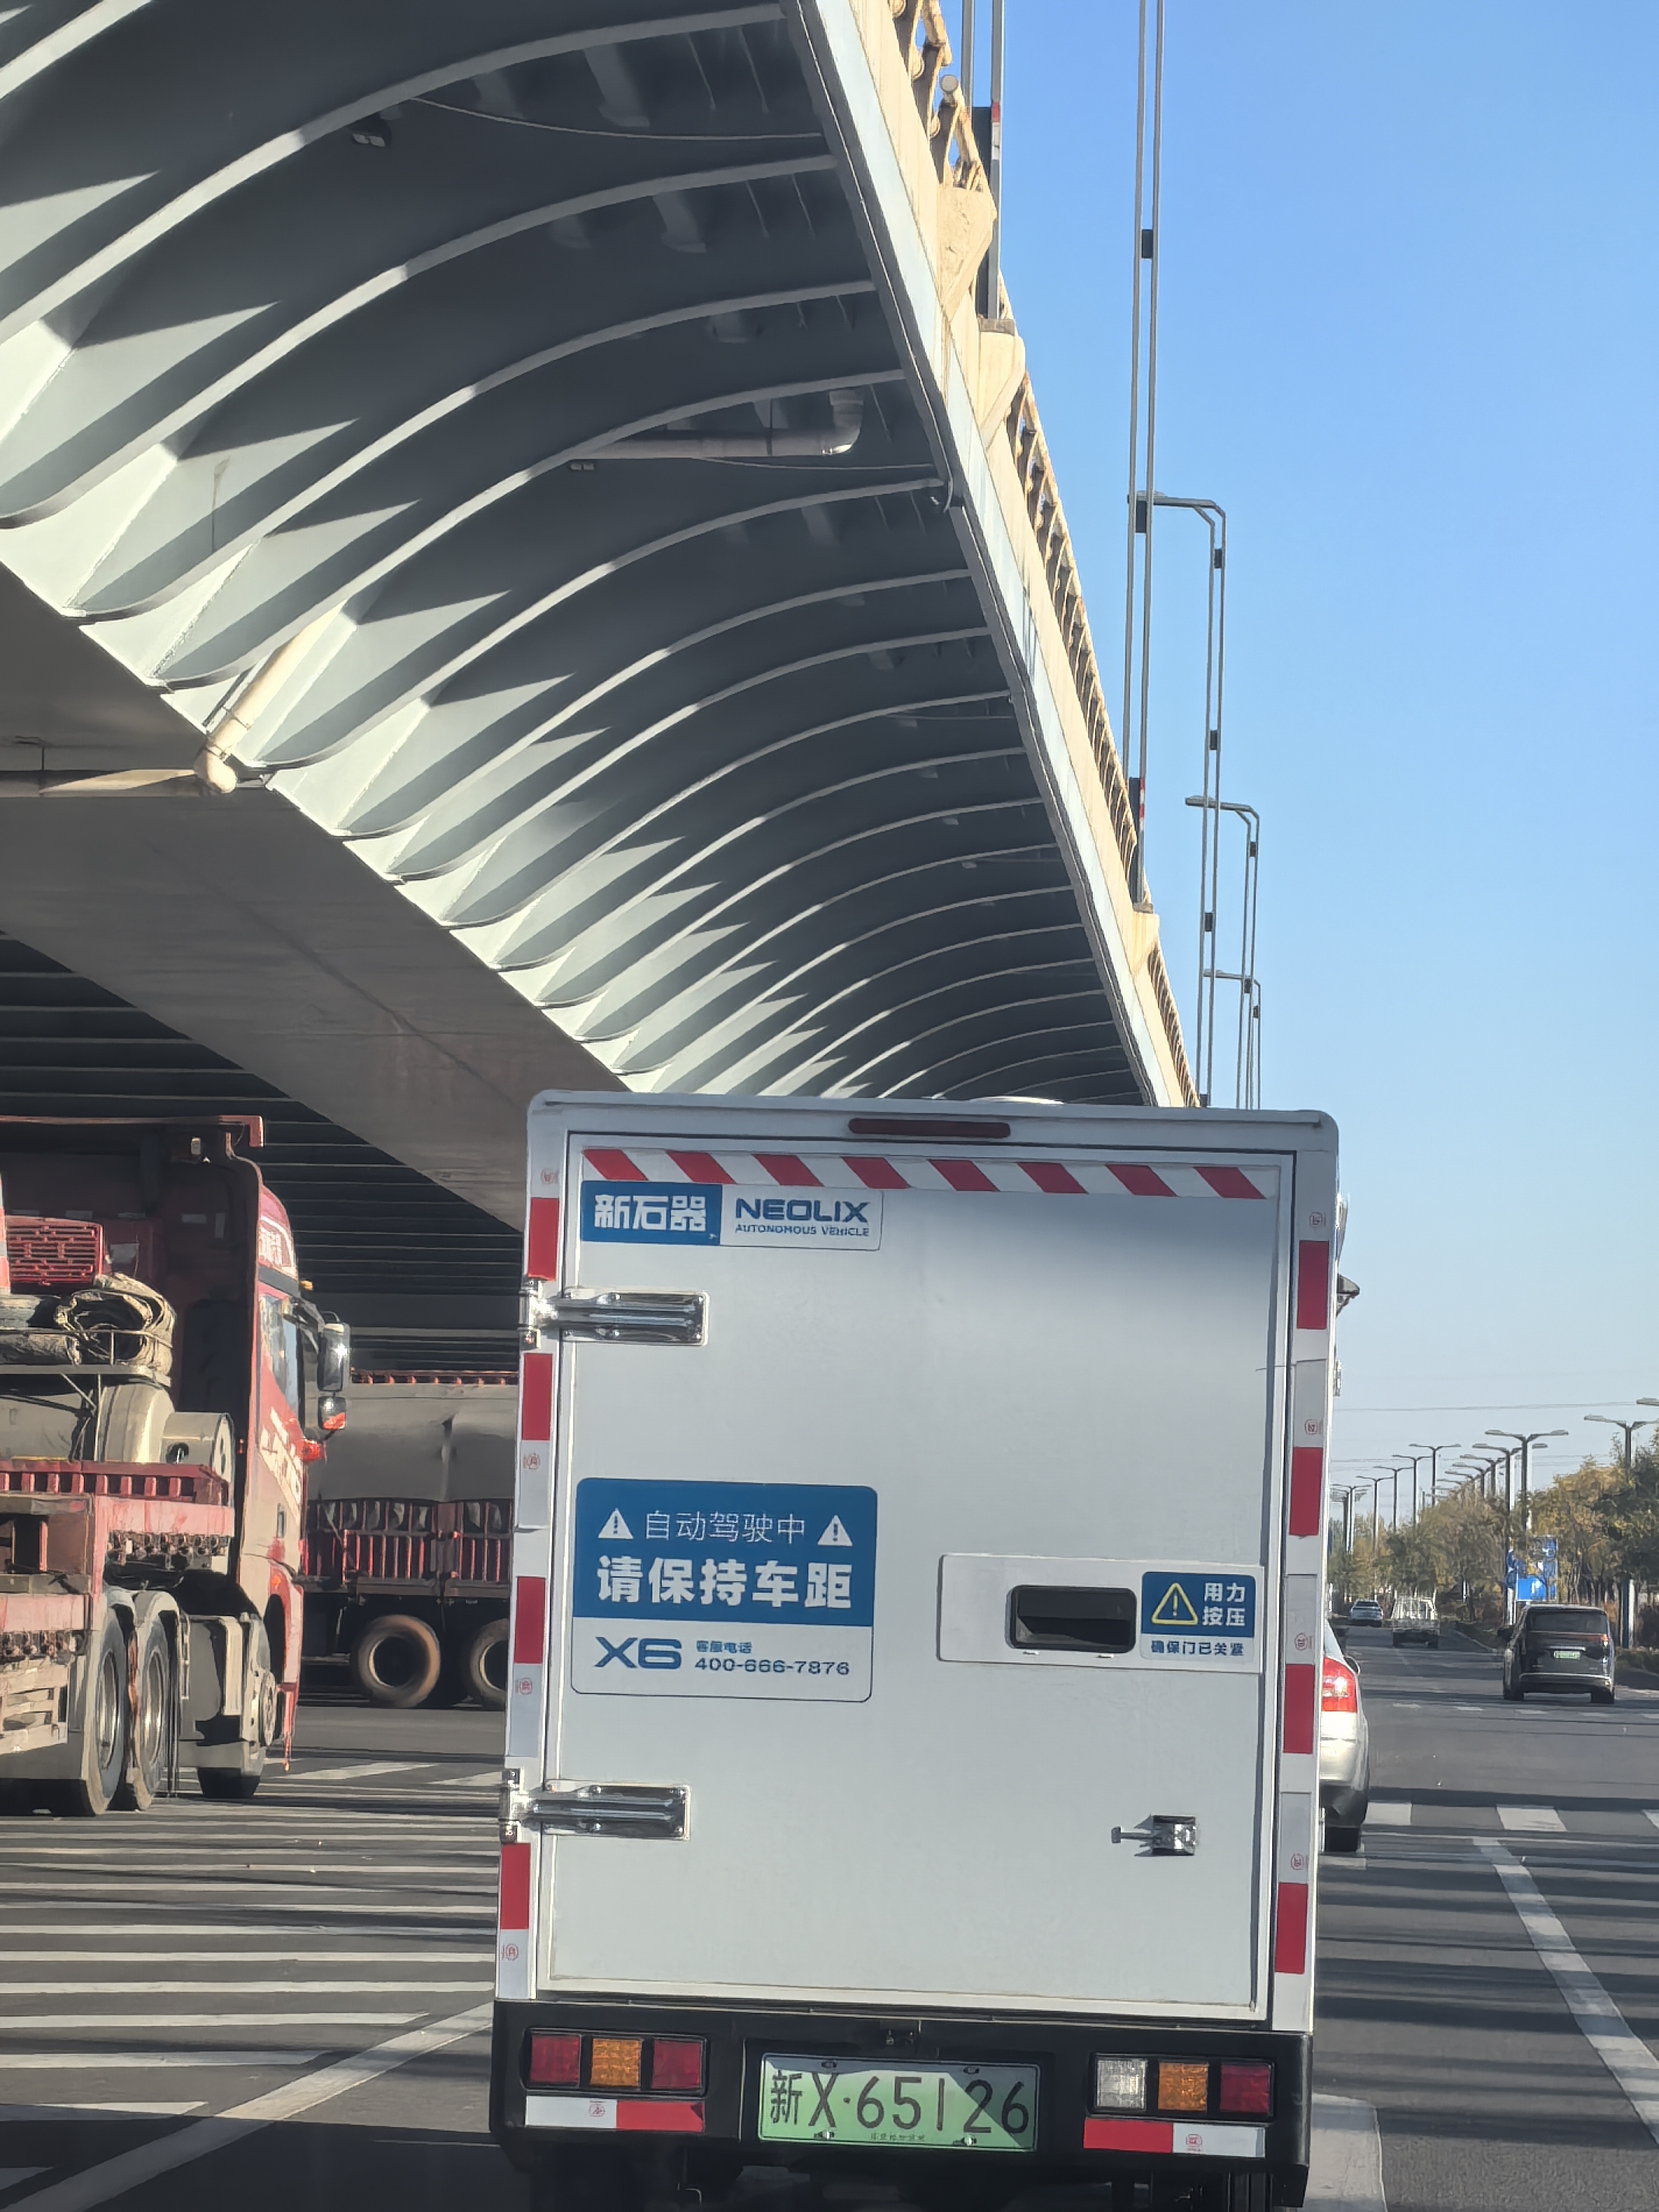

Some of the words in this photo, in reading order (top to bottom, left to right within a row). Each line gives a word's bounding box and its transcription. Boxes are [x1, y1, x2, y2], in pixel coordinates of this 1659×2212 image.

[594, 1195, 707, 1231] 新石器
[735, 1198, 870, 1224] NEOLIX
[735, 1224, 817, 1236] AUTONOMOUS
[822, 1226, 870, 1237] VEHICLE
[646, 1510, 805, 1545] 自动驾驶中
[597, 1555, 852, 1609] 请保持车距
[1204, 1582, 1245, 1602] 用力
[1202, 1606, 1245, 1627] 按压
[595, 1636, 682, 1669] X6
[696, 1640, 753, 1654] 客服电话
[694, 1657, 850, 1675] 400-666-7876
